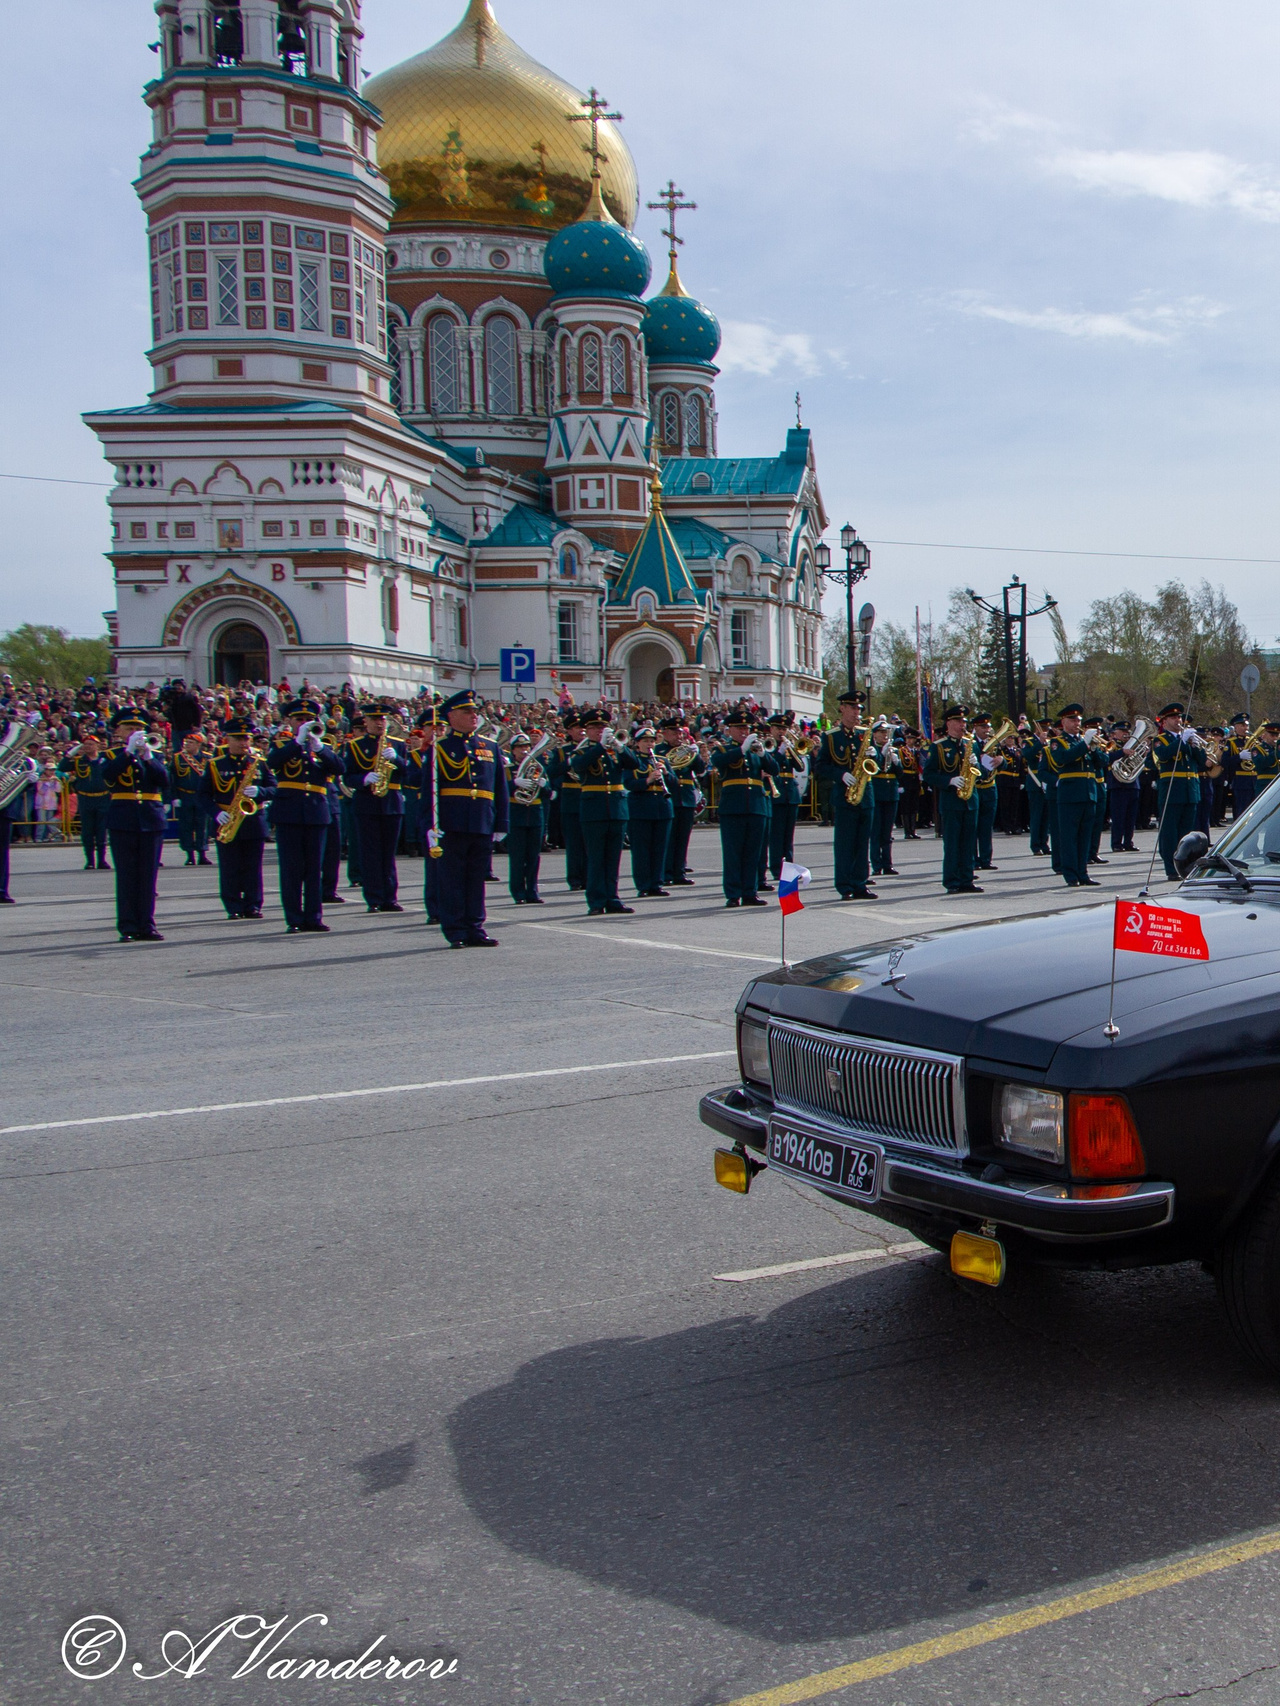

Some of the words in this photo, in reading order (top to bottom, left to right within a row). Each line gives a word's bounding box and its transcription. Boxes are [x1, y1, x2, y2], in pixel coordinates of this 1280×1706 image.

[511, 652, 530, 680] P
[850, 1150, 868, 1176] 76
[847, 1173, 864, 1188] RUS
